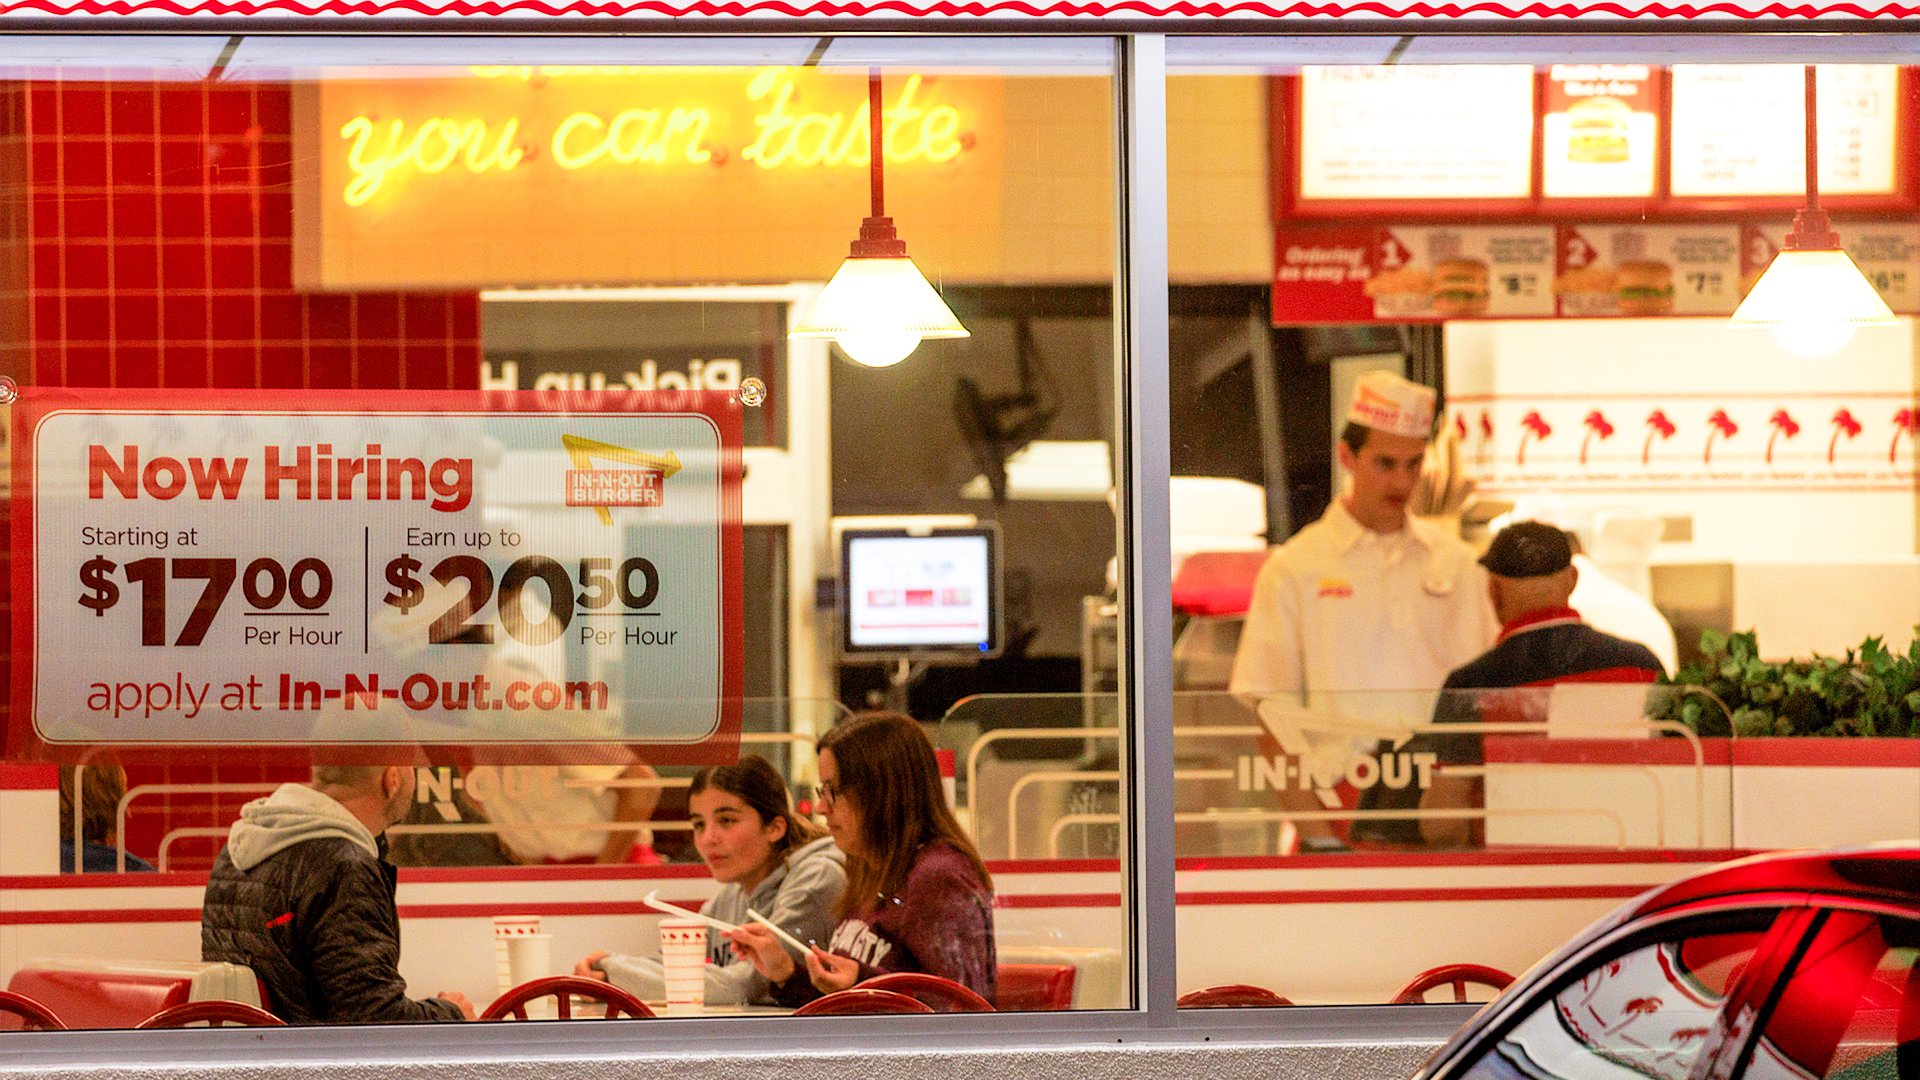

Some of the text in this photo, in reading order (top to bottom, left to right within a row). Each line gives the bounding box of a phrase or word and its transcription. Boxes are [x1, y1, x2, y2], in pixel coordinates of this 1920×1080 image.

[341, 73, 962, 207] you can taste
[89, 443, 473, 513] Now Hiring
[574, 473, 657, 488] IN-N-OUT
[574, 488, 656, 503] BURGER
[81, 526, 199, 550] Starting at
[407, 527, 521, 551] Earn up to
[244, 626, 344, 646] Per Hour
[580, 626, 679, 646] Per Hour
[87, 672, 609, 719] apply at In-N-Out.com
